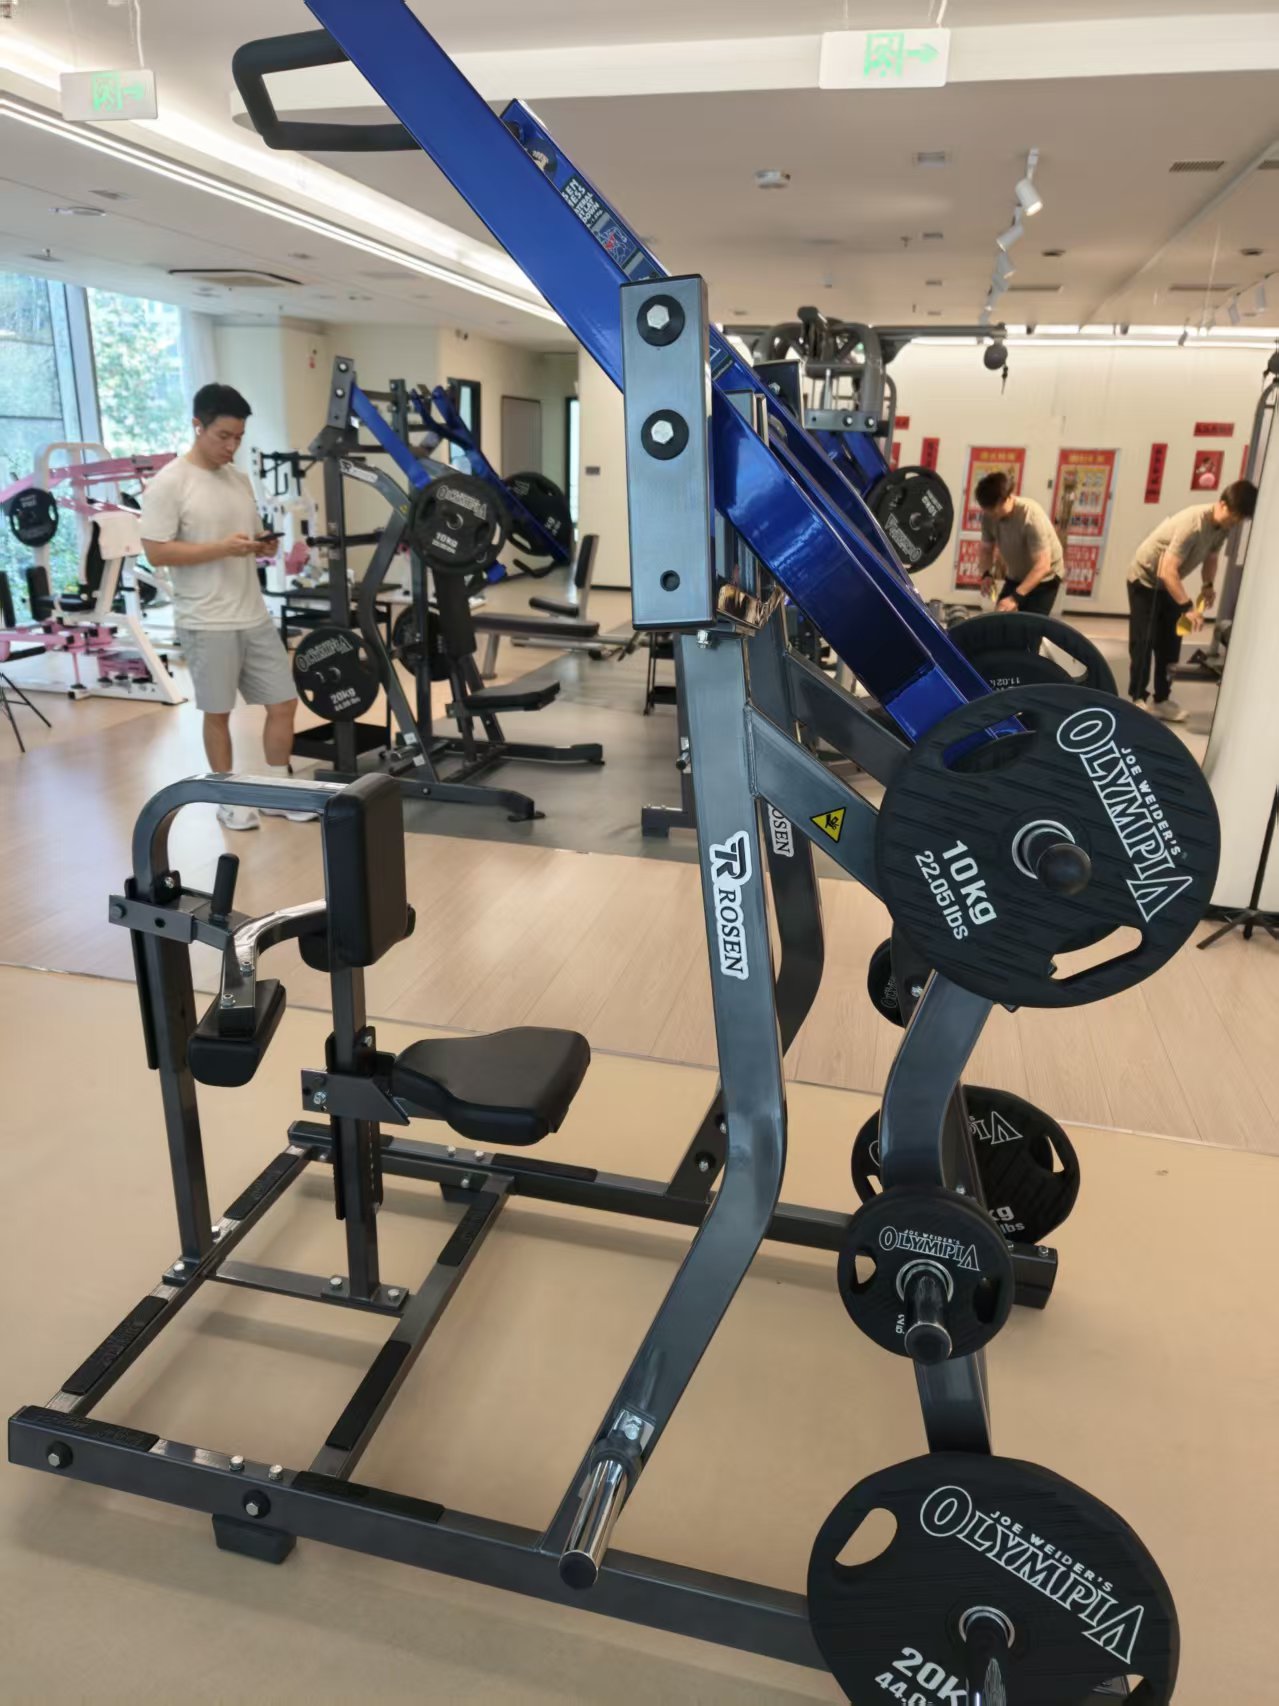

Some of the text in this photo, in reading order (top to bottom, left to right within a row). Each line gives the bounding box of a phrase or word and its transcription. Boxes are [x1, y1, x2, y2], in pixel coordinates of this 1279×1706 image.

[561, 178, 579, 200] SEN
[771, 807, 790, 855] OSEN
[1056, 706, 1193, 923] OLYMPIA
[1121, 746, 1182, 857] JOE WEIDER'S
[718, 887, 744, 974] ROSEN
[878, 1225, 982, 1272] OLYMPIA
[903, 1229, 961, 1246] JOE WEIDER'S
[920, 1485, 1145, 1665] OLYMPIA
[990, 1510, 1115, 1593] JOE WEIDER'S
[892, 1646, 968, 1706] 20k
